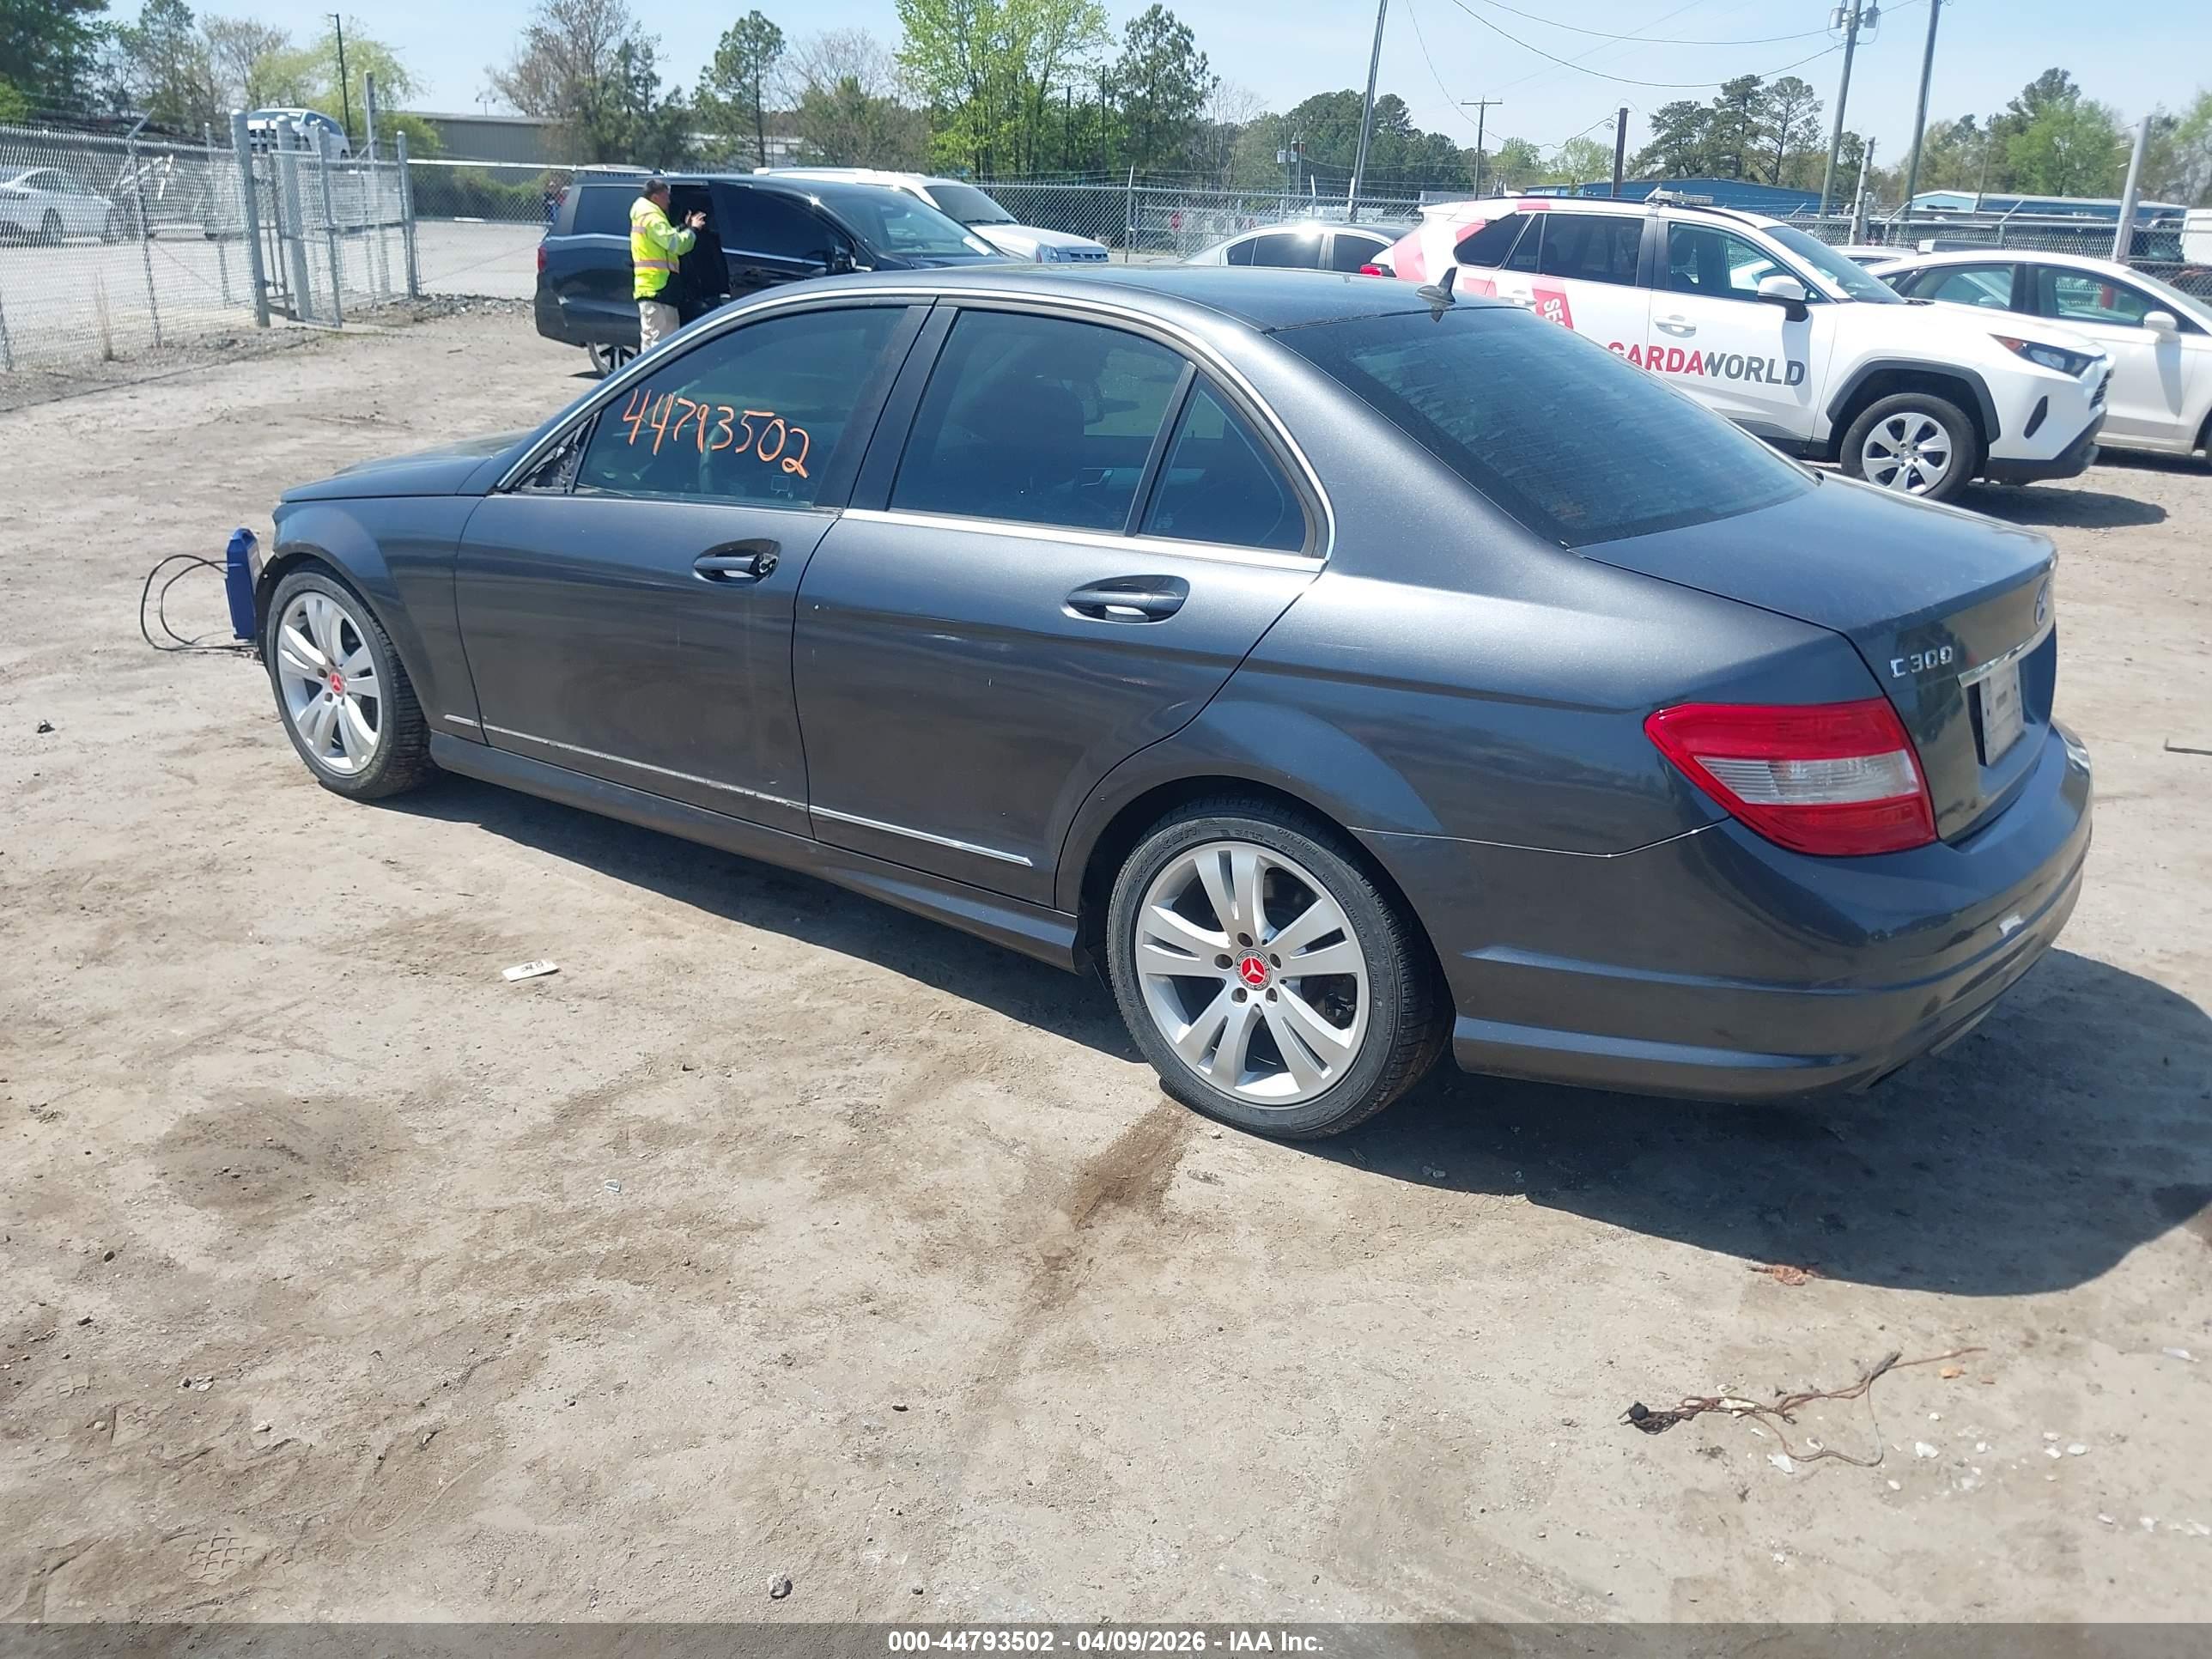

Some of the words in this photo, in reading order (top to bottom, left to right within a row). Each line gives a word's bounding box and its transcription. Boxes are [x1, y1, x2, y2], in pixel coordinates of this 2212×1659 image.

[623, 389, 810, 478] 44793502
[1890, 658, 1906, 678] C
[1910, 645, 1953, 673] 300
